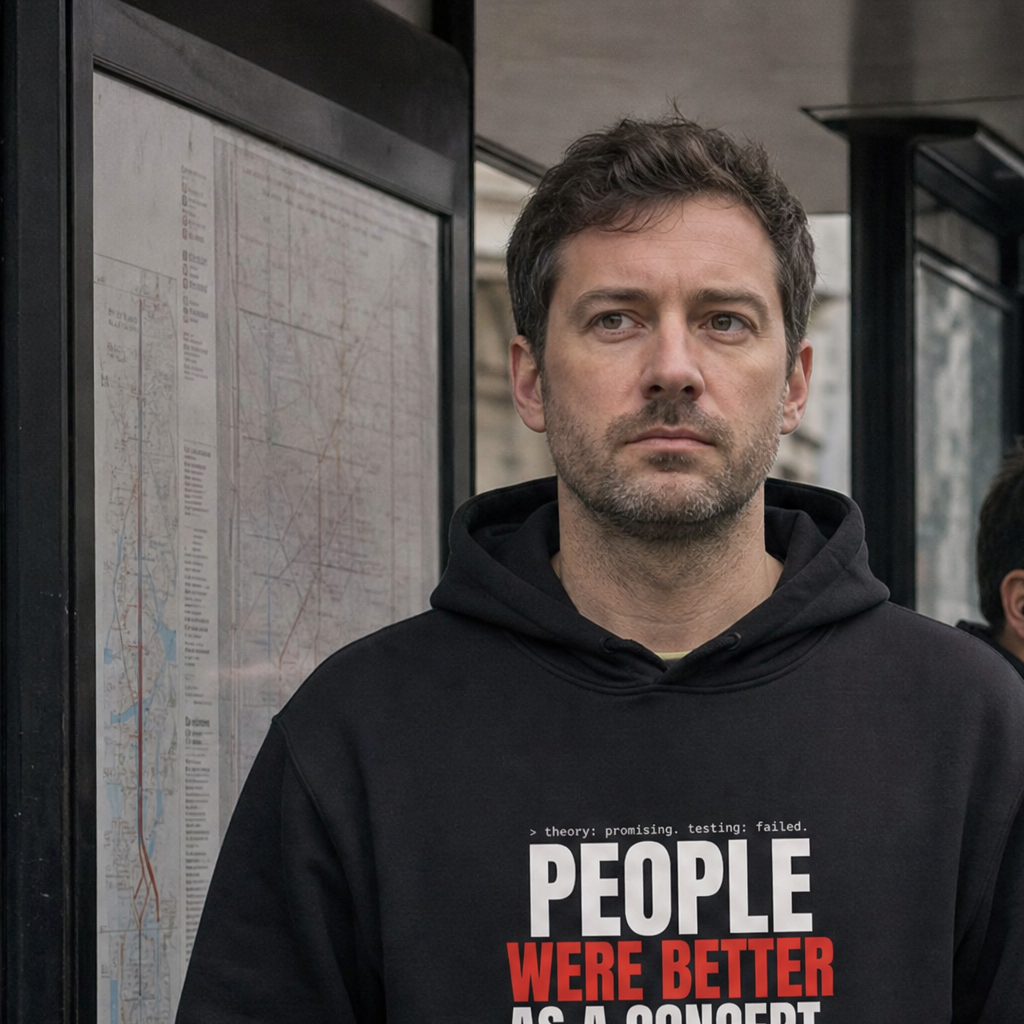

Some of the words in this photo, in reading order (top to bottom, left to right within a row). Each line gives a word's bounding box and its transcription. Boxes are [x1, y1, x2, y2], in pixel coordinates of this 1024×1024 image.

[544, 826, 596, 839] theory:
[605, 823, 679, 838] promising.
[688, 822, 747, 836] testing:
[755, 820, 808, 832] failed.
[529, 838, 813, 938] PEOPLE
[506, 940, 644, 1003] WERE
[661, 936, 834, 1000] BETTER
